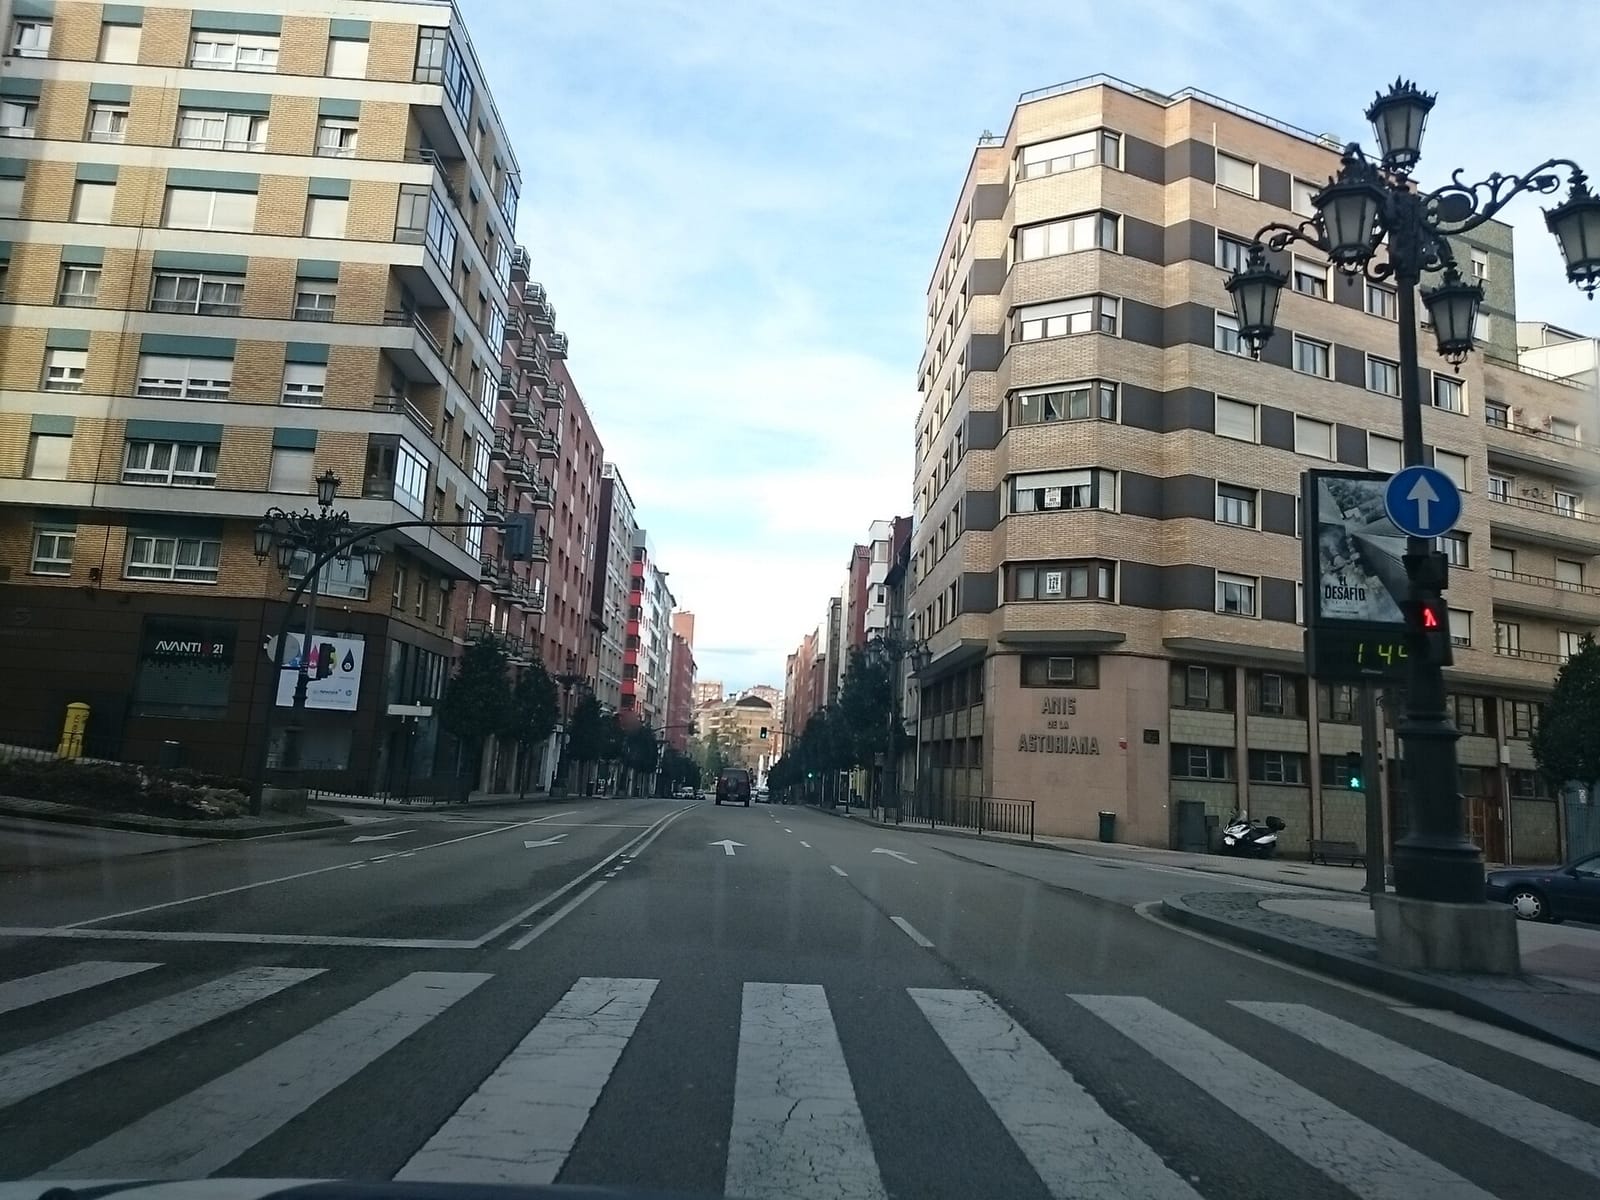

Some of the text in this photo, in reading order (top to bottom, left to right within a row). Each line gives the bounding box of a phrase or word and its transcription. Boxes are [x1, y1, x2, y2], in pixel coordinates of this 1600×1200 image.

[1325, 584, 1366, 601] DESAFÍO
[155, 641, 223, 654] AVANTI 21
[1042, 696, 1076, 715] ANIS
[1018, 733, 1100, 756] ASTURIANA
